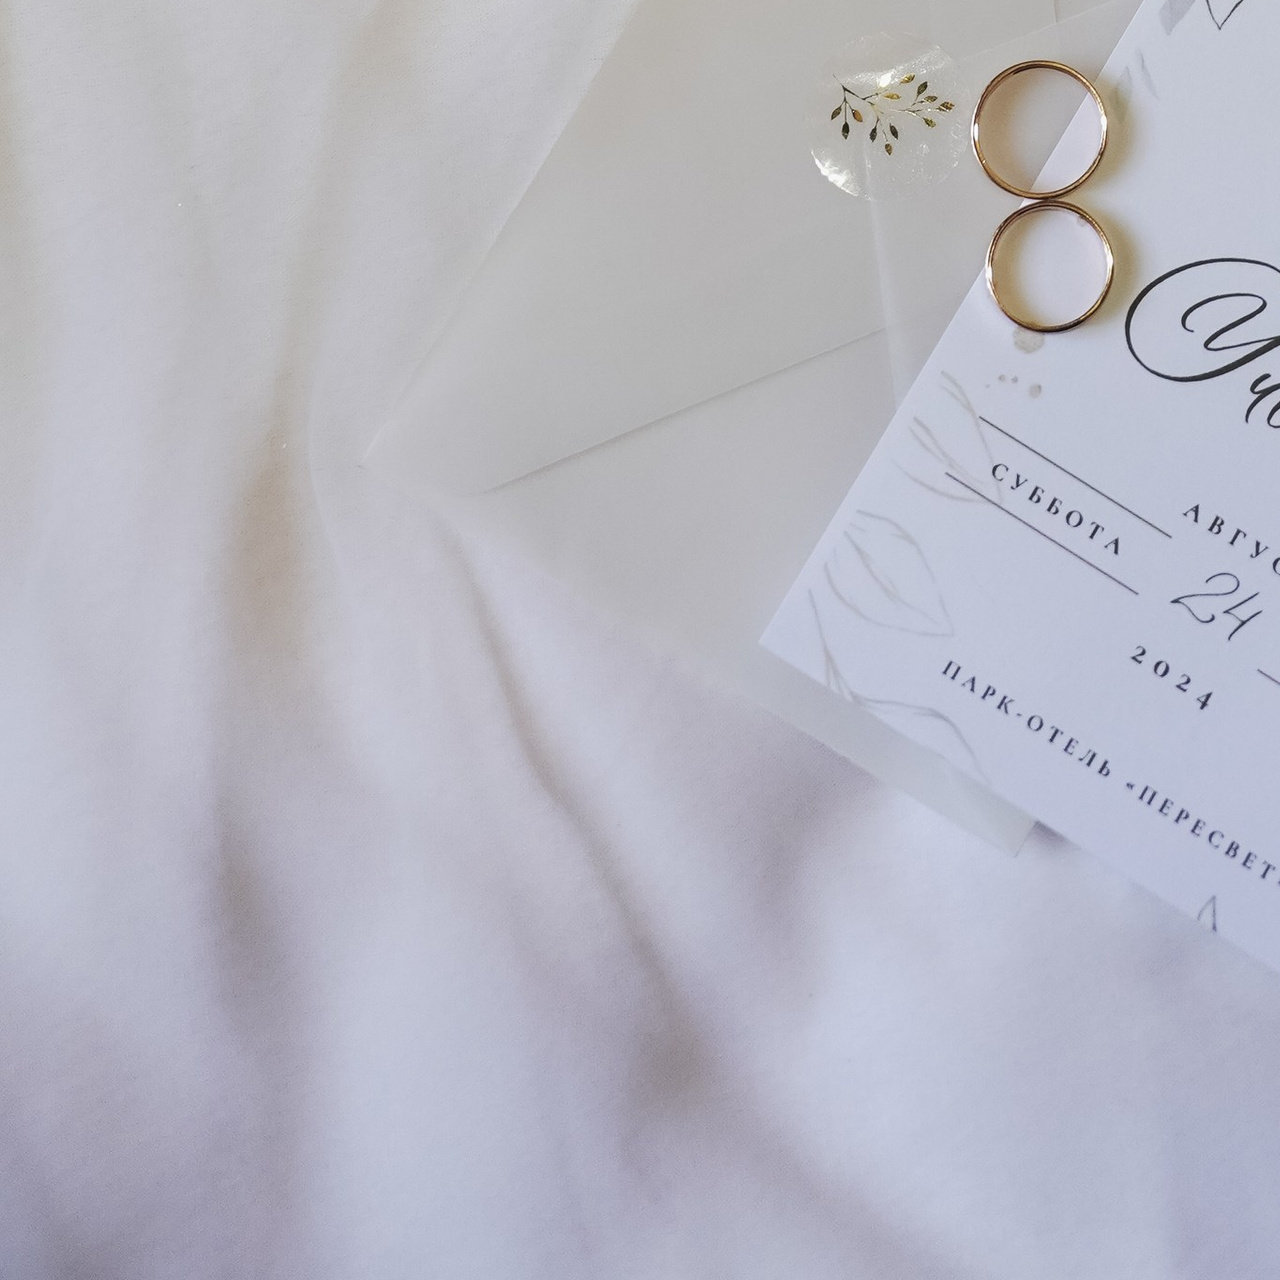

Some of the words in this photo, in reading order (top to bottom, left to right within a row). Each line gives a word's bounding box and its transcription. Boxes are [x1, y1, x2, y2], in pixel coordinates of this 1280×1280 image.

[991, 463, 1120, 556] СУББОТА
[1169, 571, 1264, 642] 24
[1130, 645, 1214, 711] 2024
[941, 660, 1112, 779] ПАРК-ОТЕЛЬ
